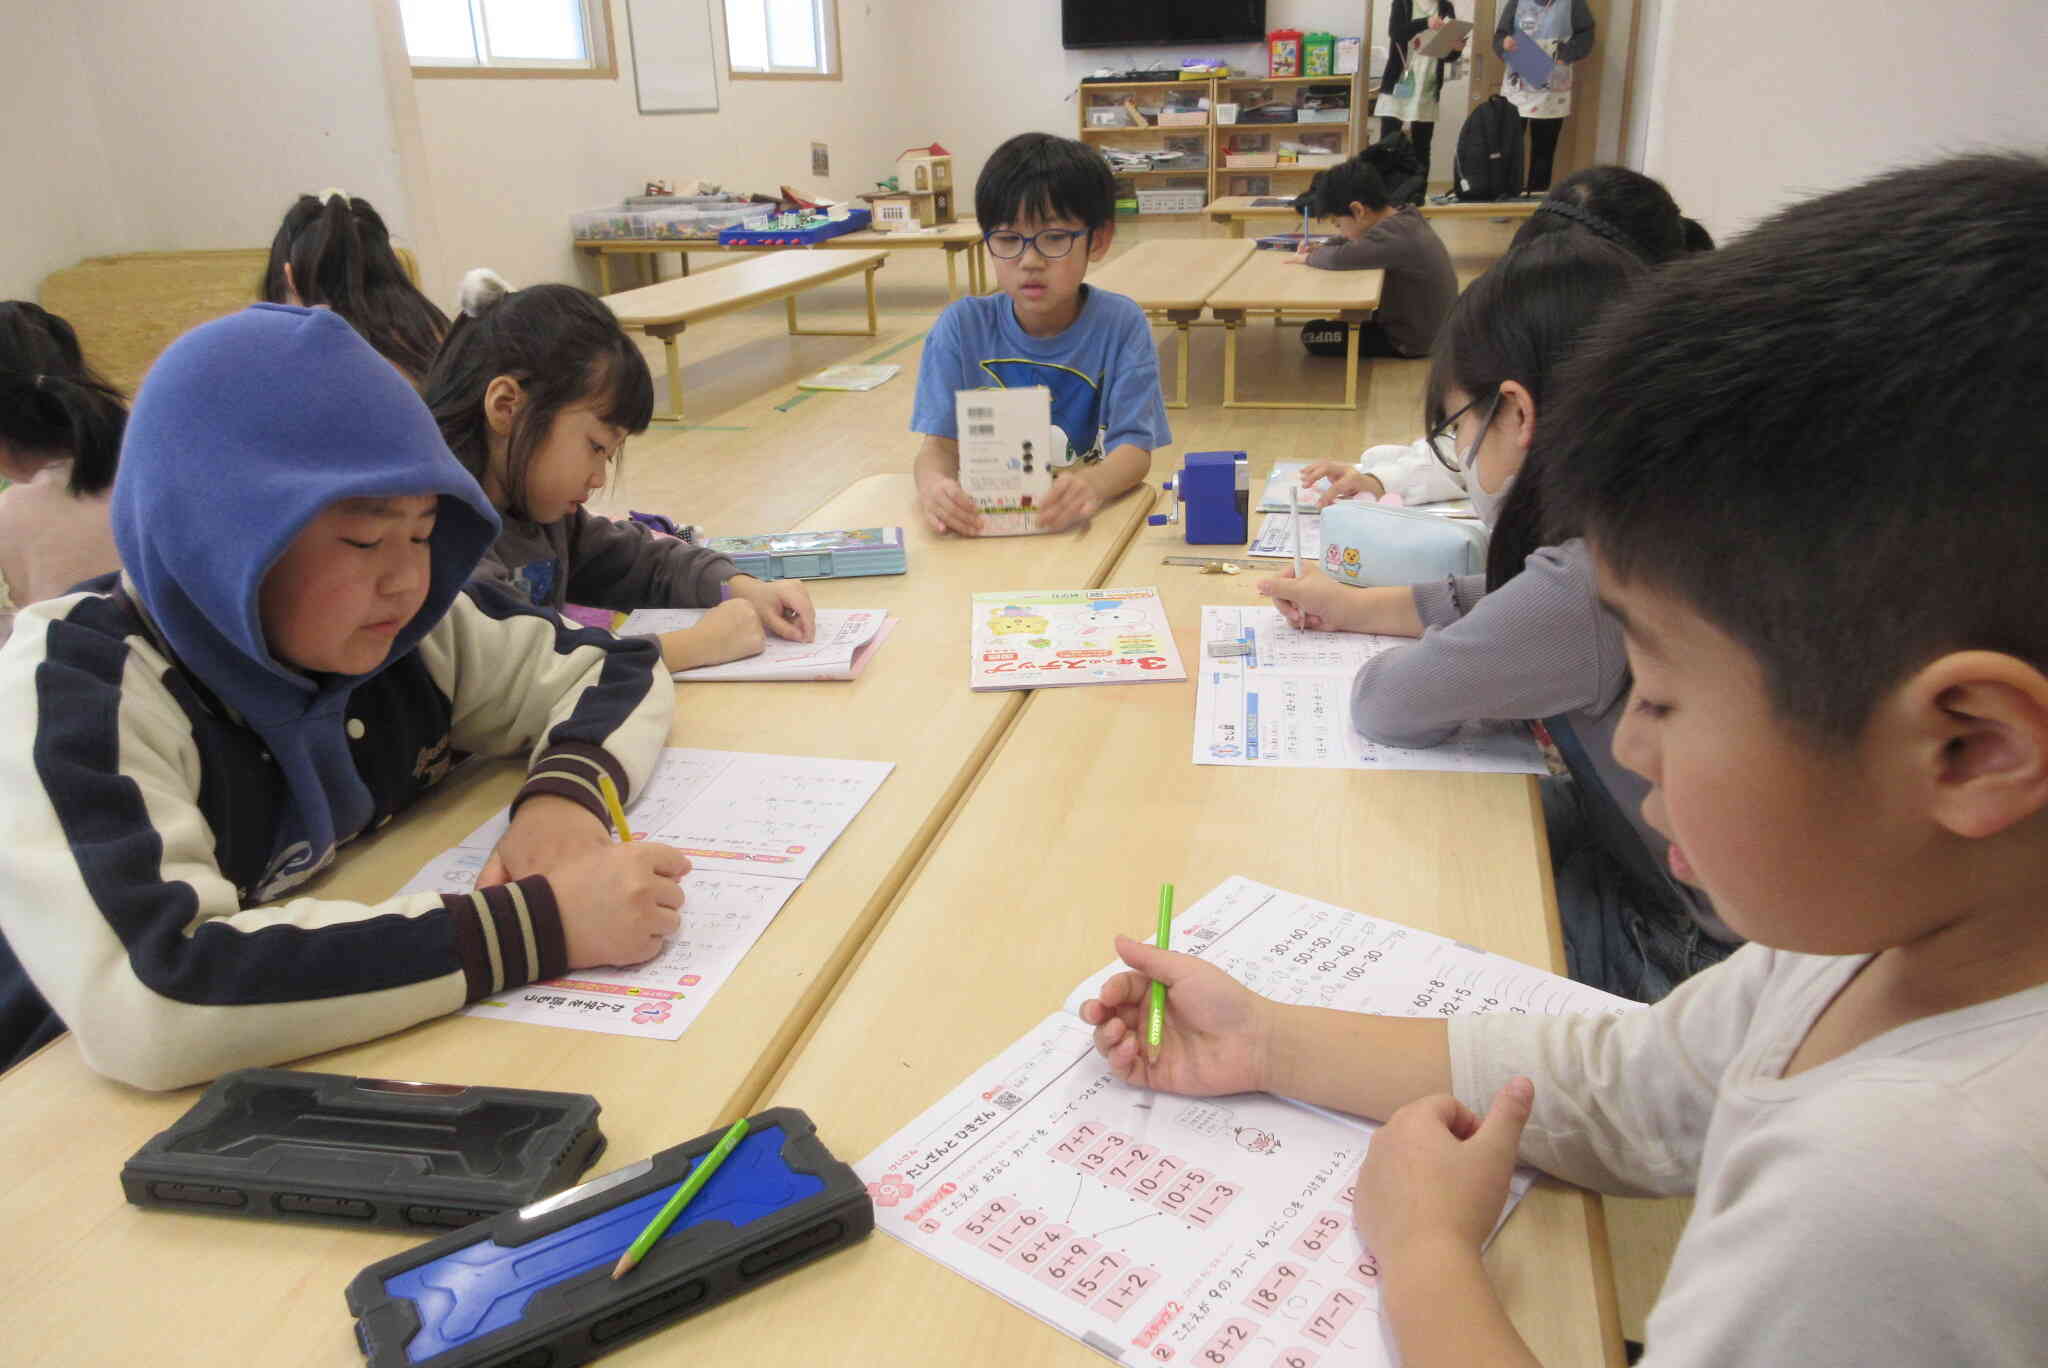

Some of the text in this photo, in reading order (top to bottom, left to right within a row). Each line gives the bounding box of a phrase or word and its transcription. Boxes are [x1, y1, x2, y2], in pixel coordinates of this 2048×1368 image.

[1270, 928, 1308, 957] 30+60
[1293, 936, 1332, 965] 50+50
[1413, 980, 1445, 1008] 60+8
[1438, 987, 1472, 1016] 82+5
[1058, 1125, 1096, 1153] 7+7
[1080, 1135, 1124, 1170] 13-3
[1110, 1149, 1149, 1178] 7-2
[1134, 1159, 1176, 1196] 10-7
[1162, 1171, 1205, 1209] 10+5
[1189, 1185, 1233, 1223] 11-3
[966, 1202, 1007, 1234] 5+9
[988, 1215, 1037, 1252] 11-6
[1303, 1216, 1339, 1250] 6+5
[1021, 1231, 1060, 1263] 6+4
[1049, 1244, 1087, 1278] 6+9
[1071, 1255, 1119, 1298] 15-7
[1106, 1273, 1148, 1308] 1+2
[1252, 1265, 1296, 1310] 18-9
[1309, 1292, 1353, 1338] 17-7
[1205, 1325, 1247, 1364] 8+2
